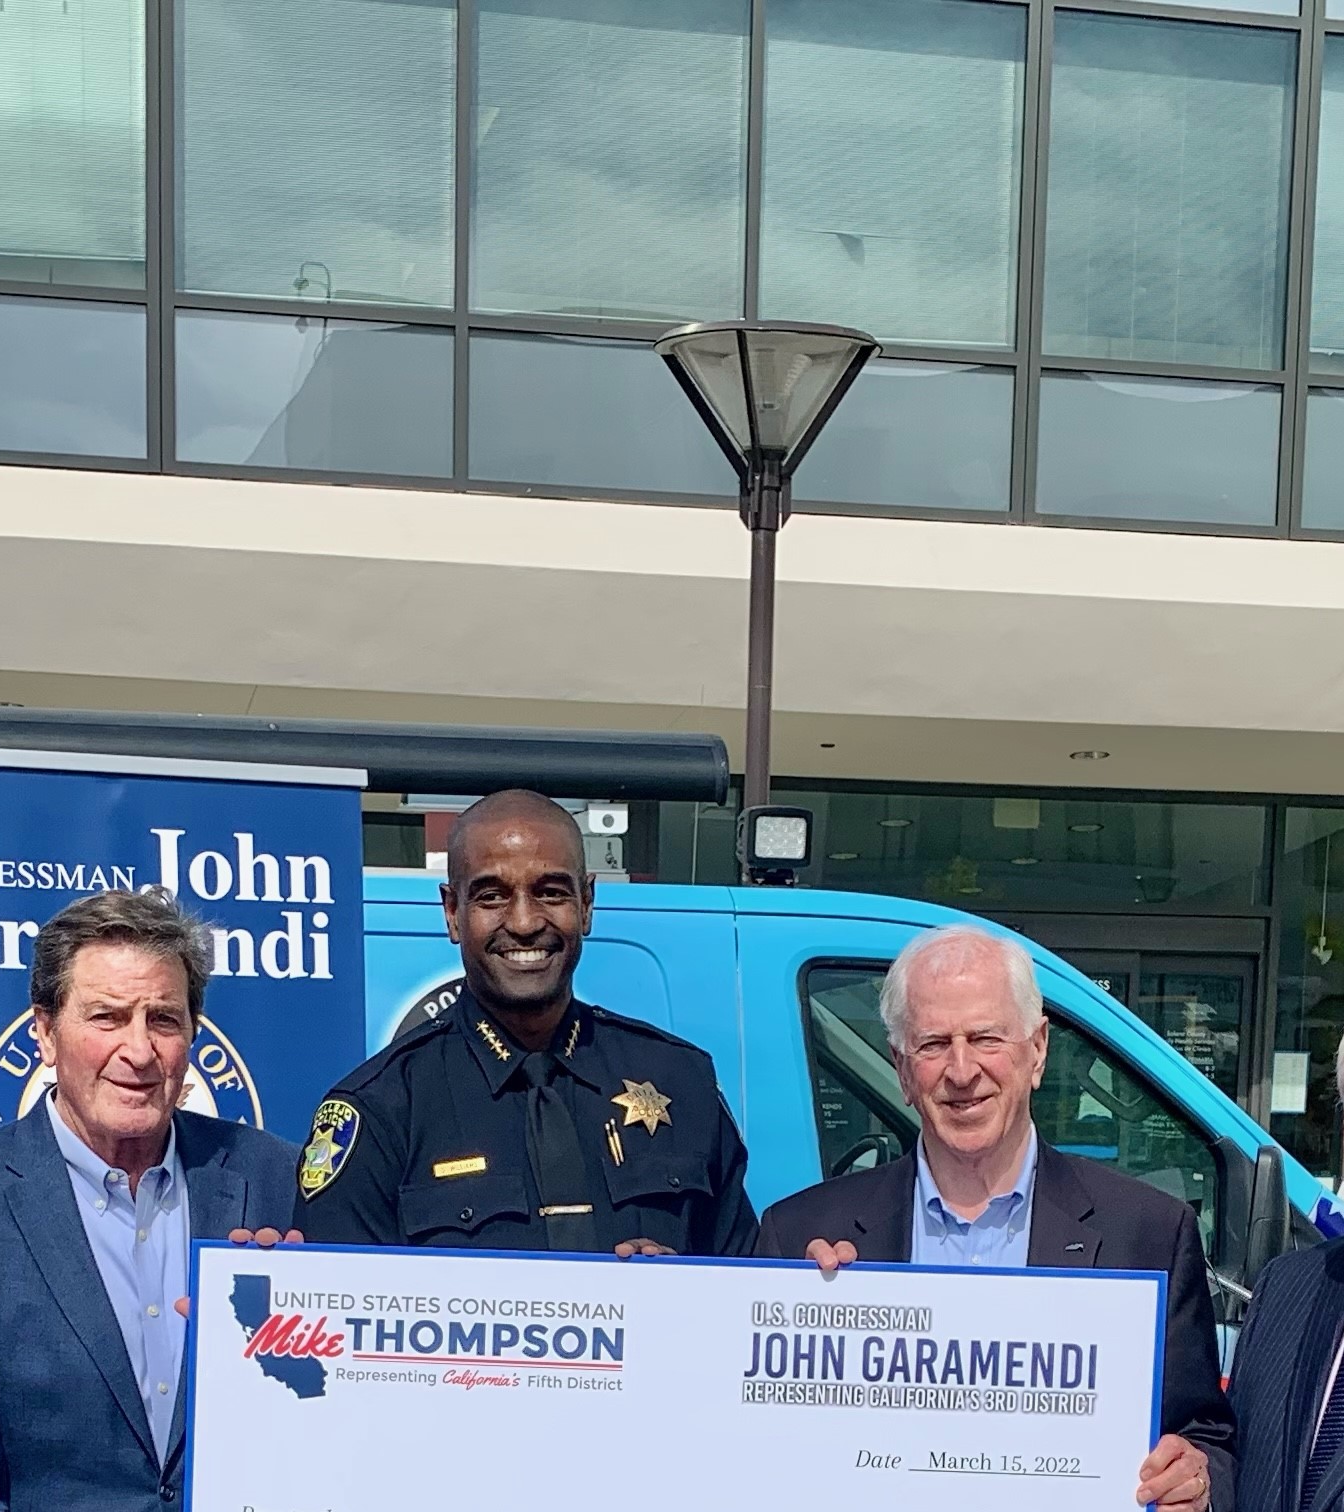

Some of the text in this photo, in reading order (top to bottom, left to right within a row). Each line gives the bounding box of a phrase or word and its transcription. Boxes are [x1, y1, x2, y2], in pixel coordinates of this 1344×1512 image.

[141, 829, 336, 904] John
[197, 1044, 244, 1092] OF
[274, 1291, 625, 1321] UNITED STATES CONGRESSMAN
[753, 1303, 932, 1332] U.S. CONGRESSMAN
[243, 1314, 625, 1362] Mike THOMPSON
[743, 1332, 1099, 1390] JOHN GARAMENDI
[336, 1368, 623, 1391] Representing California's Fifth District
[742, 1381, 1096, 1415] REPRESENTING CALIFORNIA'S 3RD DISTRICT
[855, 1450, 1081, 1474] Date March 15, 2022
